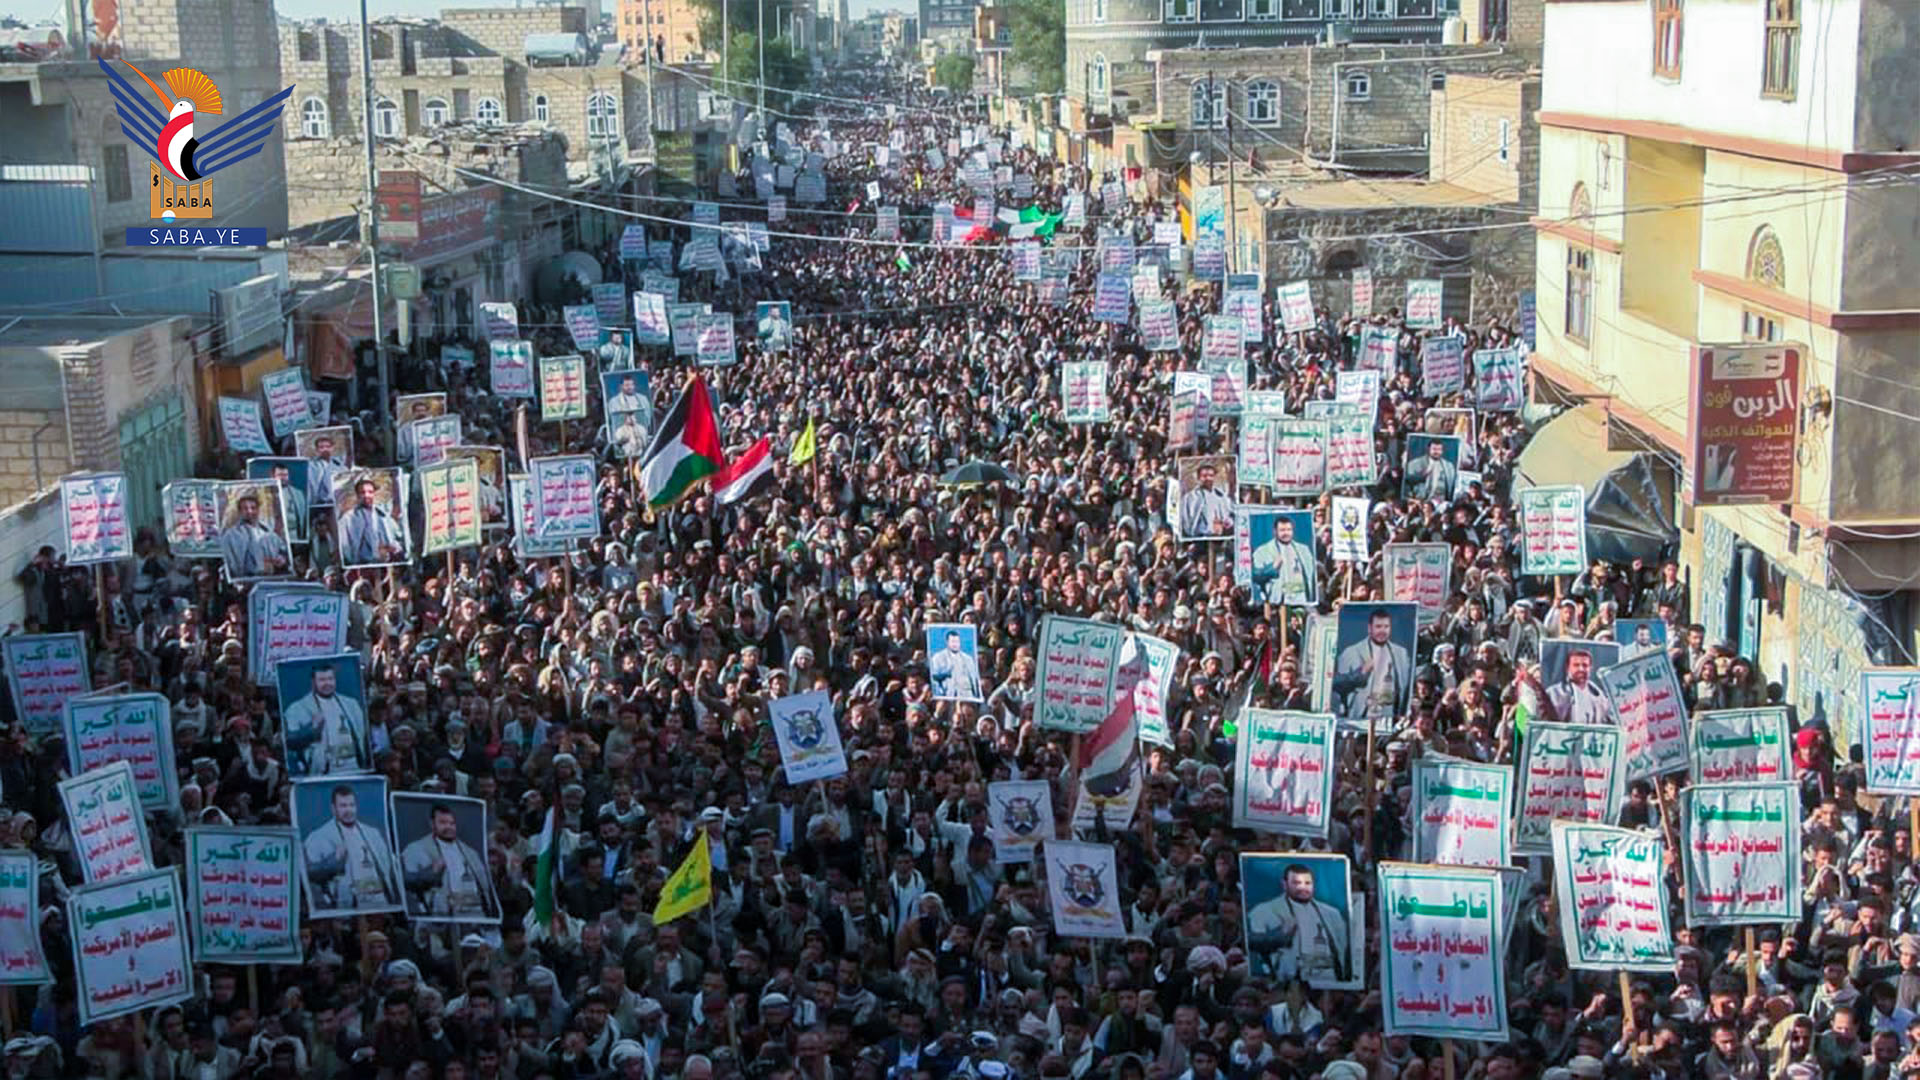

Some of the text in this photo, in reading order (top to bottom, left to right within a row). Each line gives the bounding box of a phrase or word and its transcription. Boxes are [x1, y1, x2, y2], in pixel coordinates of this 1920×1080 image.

[1733, 378, 1795, 421] الزين
[1583, 733, 1613, 758] الله
[1693, 799, 1782, 827] قاطعوا
[255, 841, 289, 862] الله
[1625, 840, 1657, 861] الله
[78, 884, 172, 930] قاطعوا
[1391, 889, 1489, 921] قاطعوا
[128, 954, 135, 972] و
[1437, 962, 1444, 984] و
